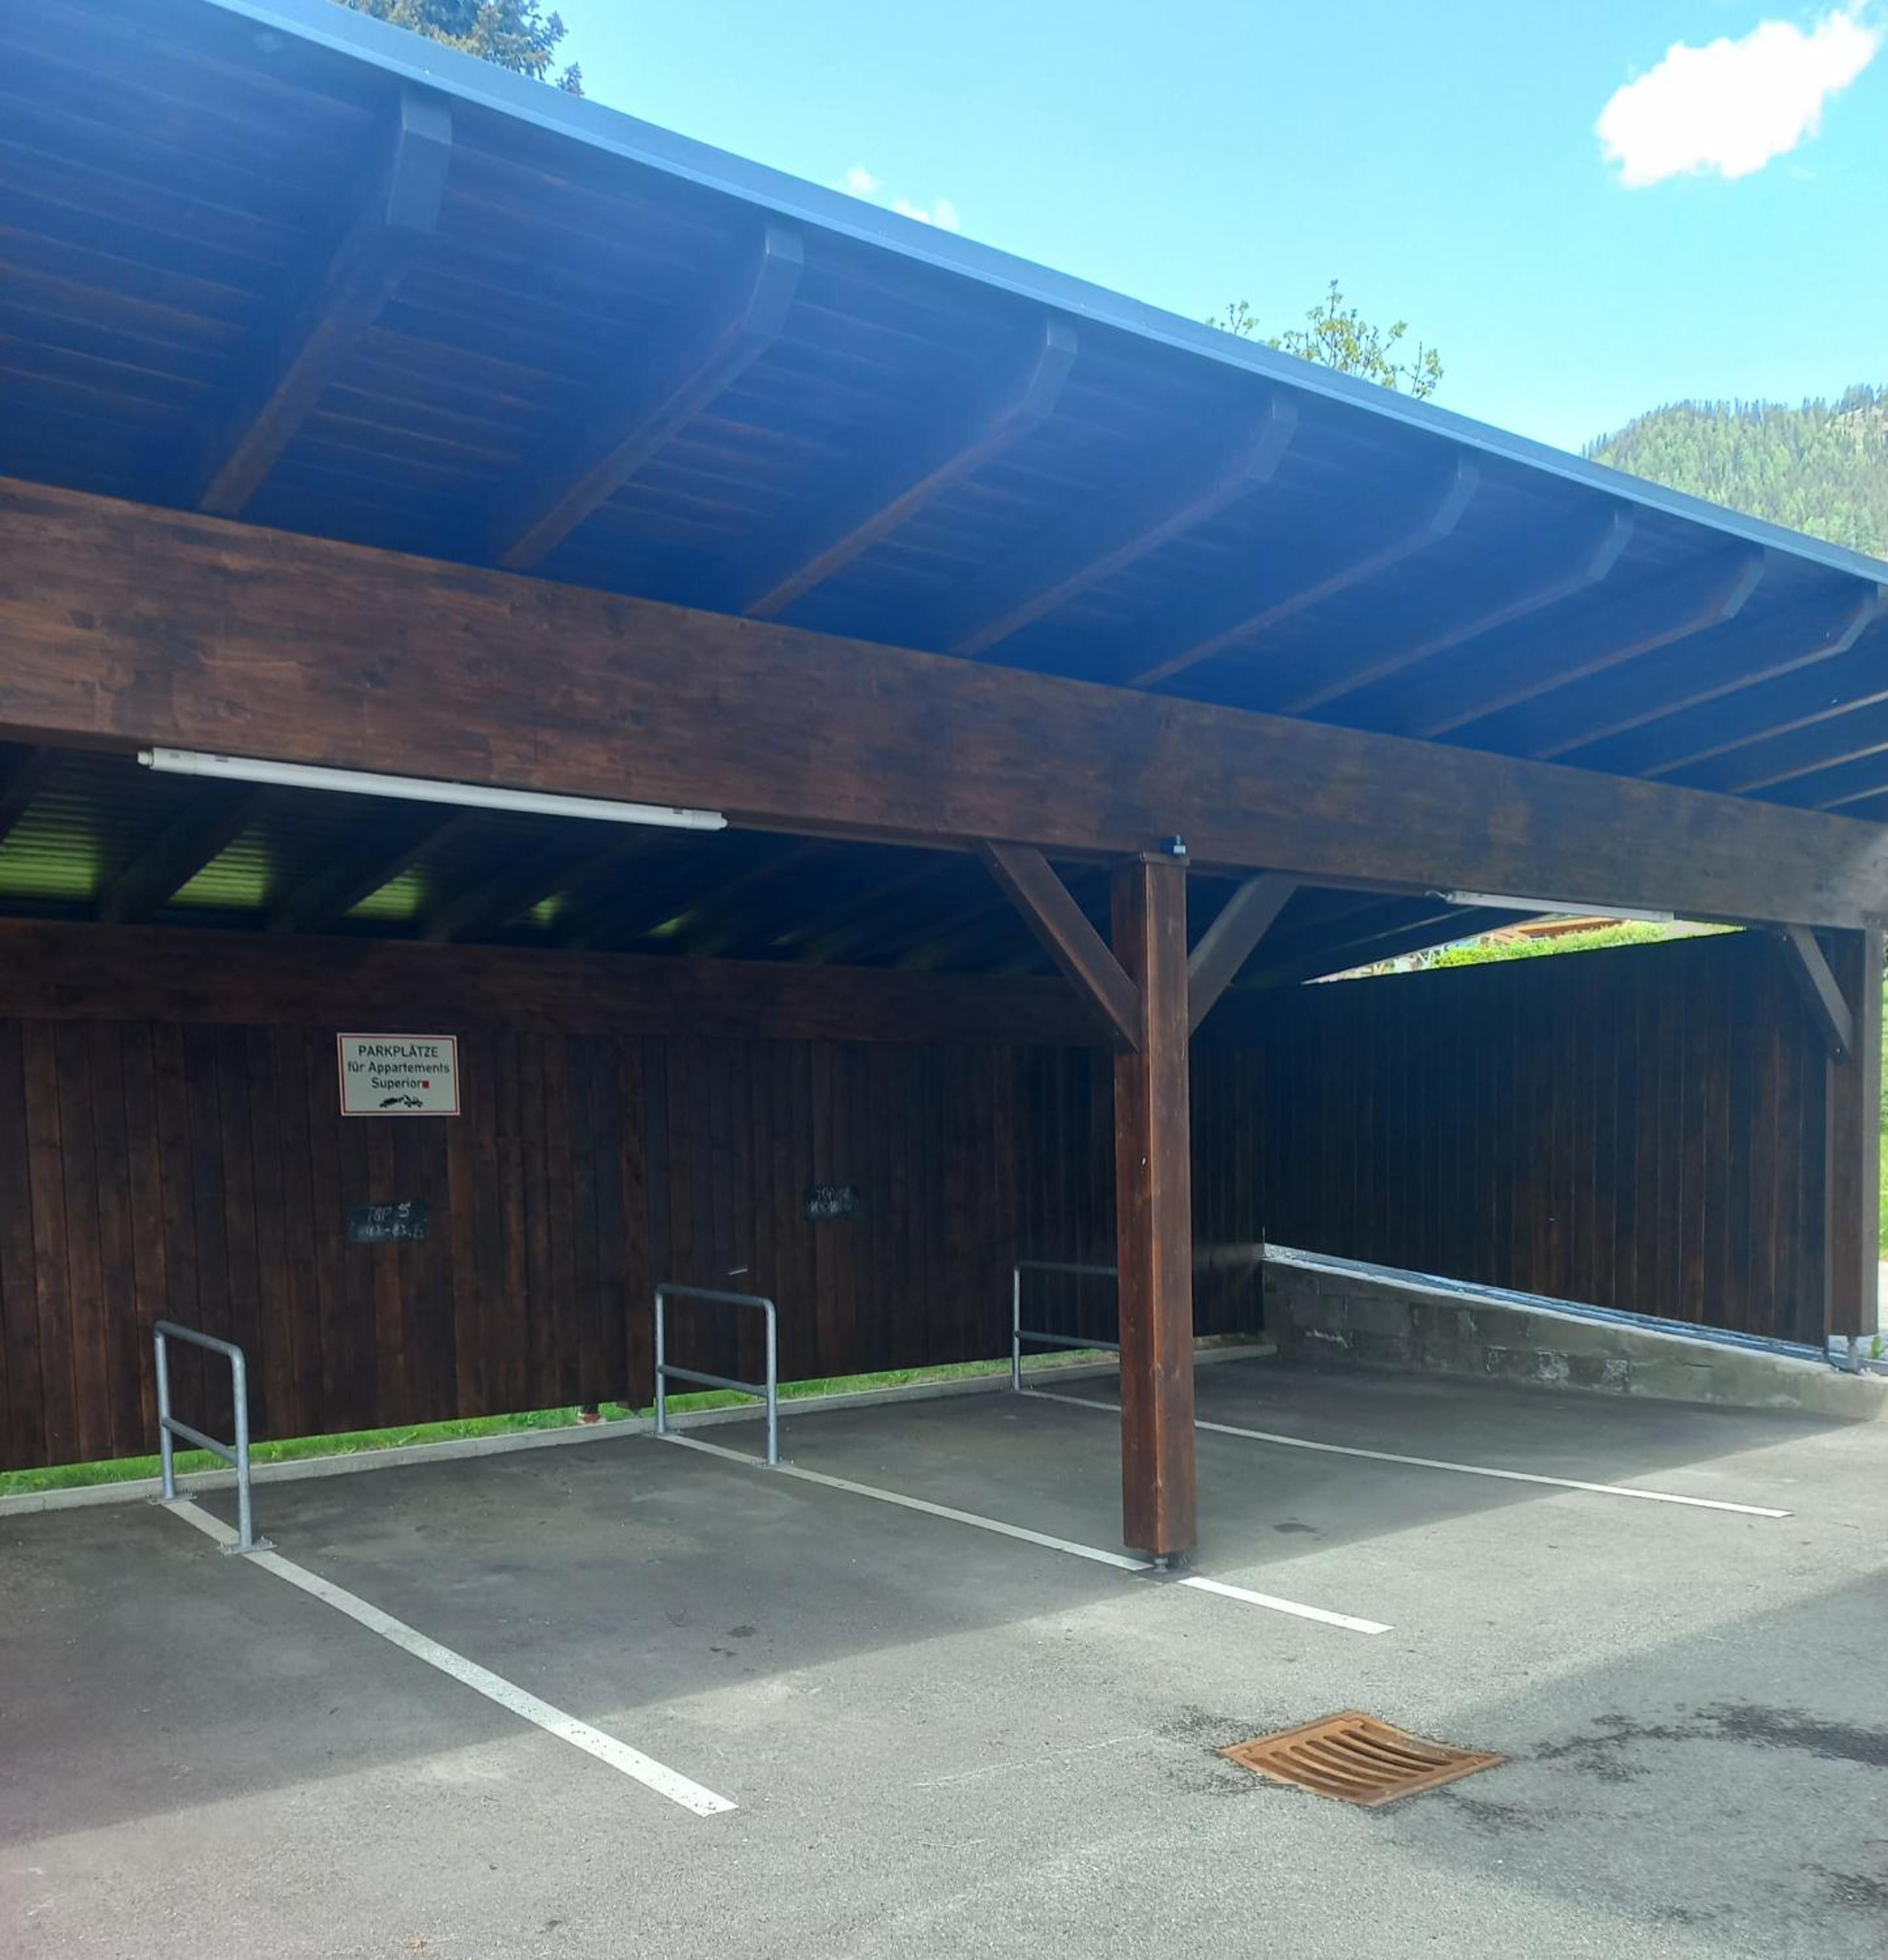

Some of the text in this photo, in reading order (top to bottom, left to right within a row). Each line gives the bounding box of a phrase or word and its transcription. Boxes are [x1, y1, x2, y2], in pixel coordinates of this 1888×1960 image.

[358, 1044, 438, 1058] PARKPLÄTZE
[348, 1060, 450, 1075] für Appartements
[371, 1077, 422, 1091] Superior
